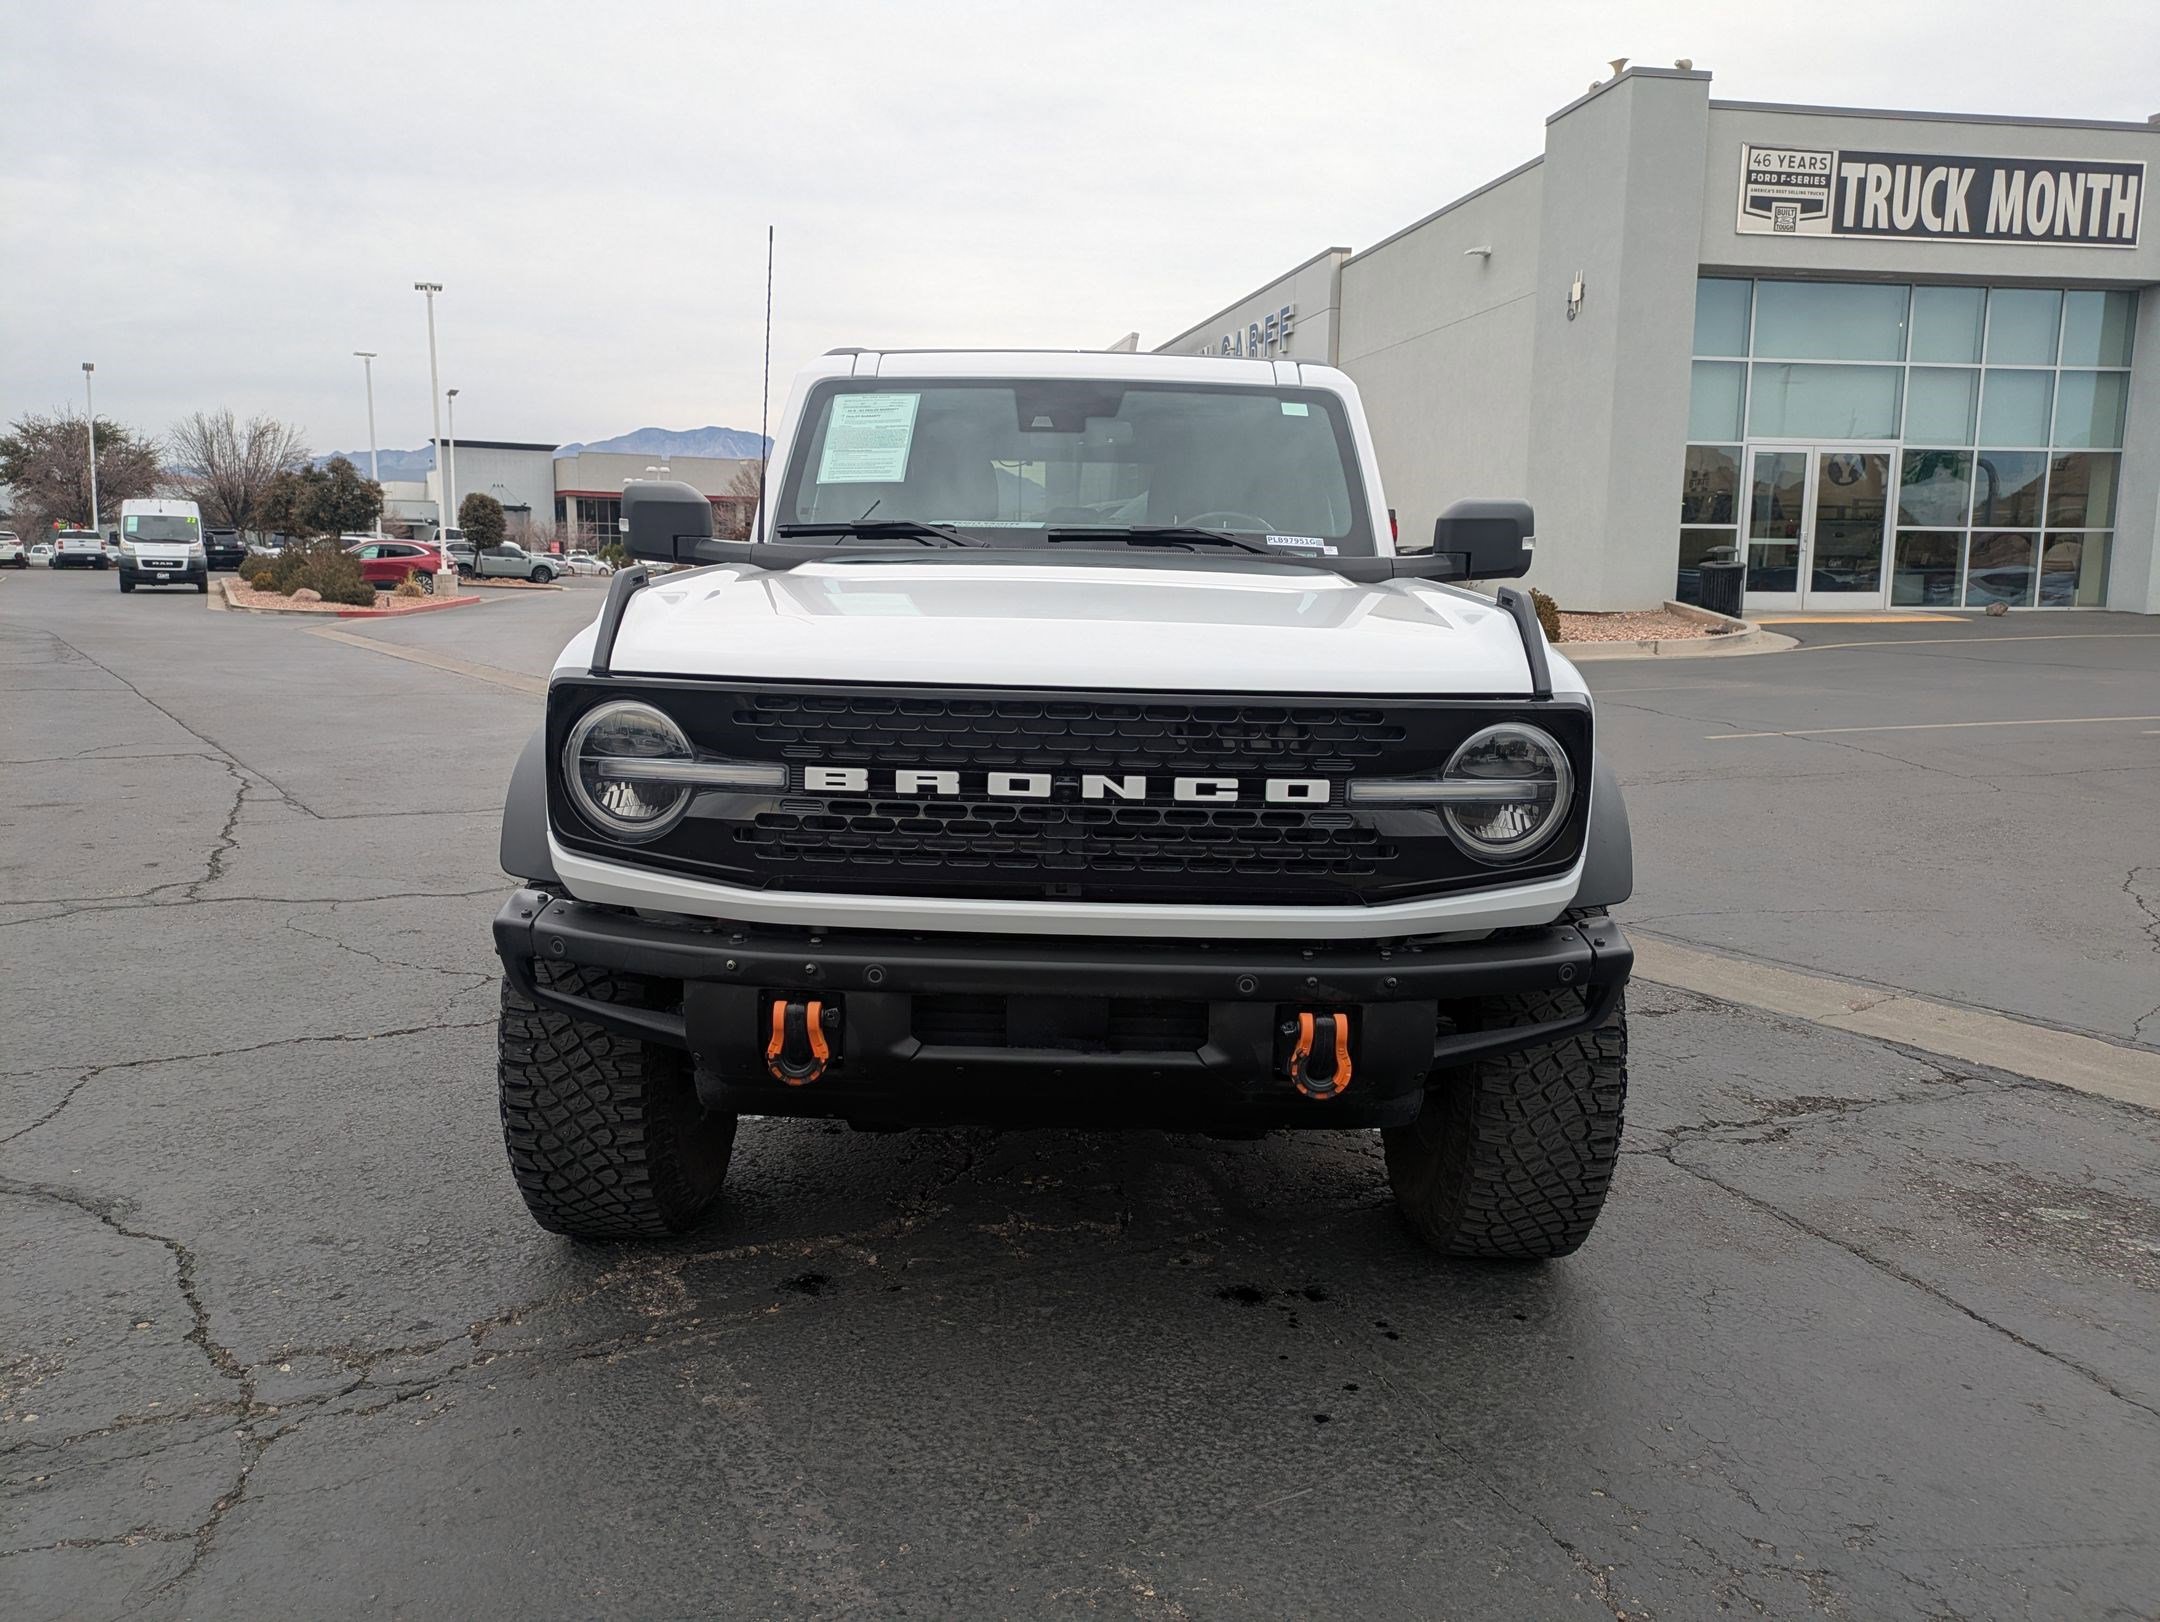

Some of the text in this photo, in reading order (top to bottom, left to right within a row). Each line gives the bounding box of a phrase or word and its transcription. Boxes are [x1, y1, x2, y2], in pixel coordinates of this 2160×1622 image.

[1753, 153, 1828, 171] 46 YEARS
[1750, 172, 1827, 186] FORD F-SERIES
[1840, 161, 2139, 239] TRUCK MONTH
[1776, 208, 1795, 217] BUILT
[1776, 223, 1794, 231] TOUGH
[803, 766, 1331, 802] BRONCO
